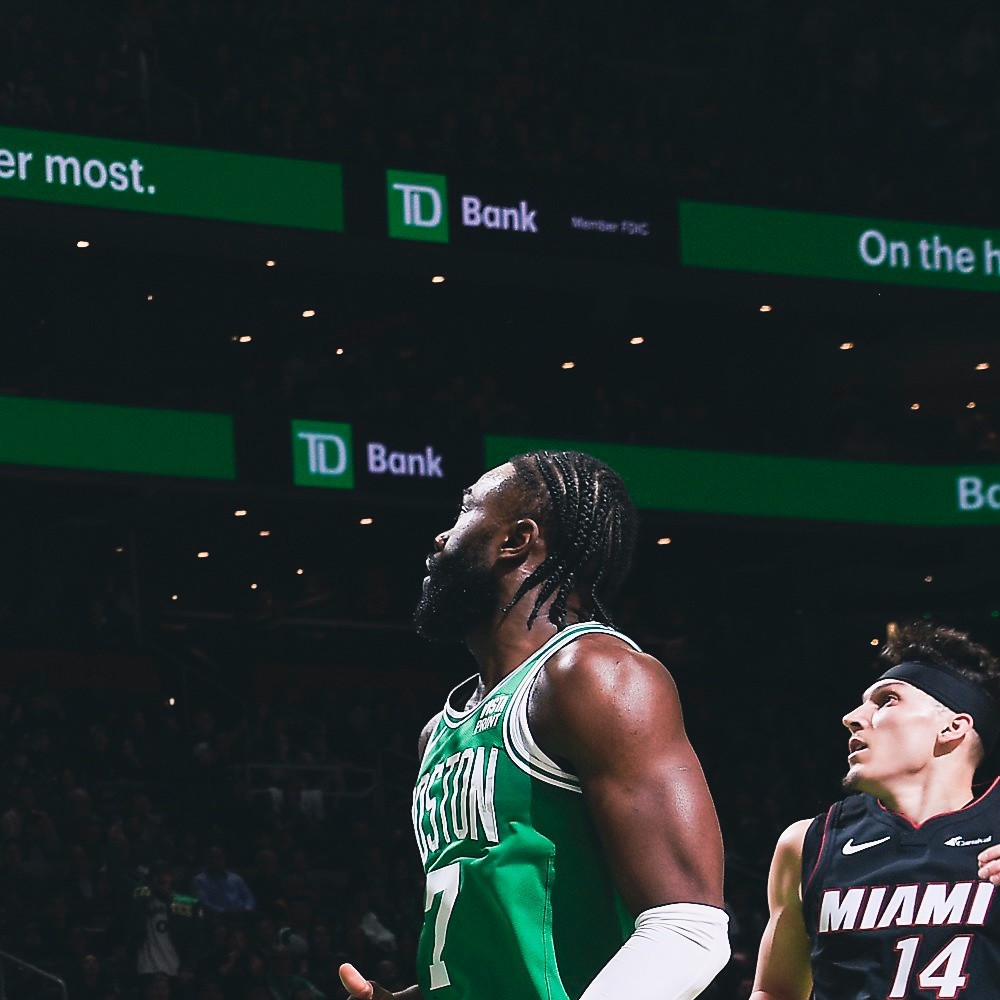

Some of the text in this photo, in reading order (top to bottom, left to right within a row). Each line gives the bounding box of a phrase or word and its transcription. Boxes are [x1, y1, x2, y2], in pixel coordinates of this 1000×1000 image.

[45, 154, 156, 195] most.
[393, 183, 538, 233] TD Bank
[859, 229, 910, 268] On
[919, 234, 976, 274] the
[298, 432, 444, 477] TD Bank
[411, 746, 500, 866] OSTON
[424, 861, 461, 991] 7
[818, 881, 995, 933] MIAMI
[888, 935, 973, 999] 14
